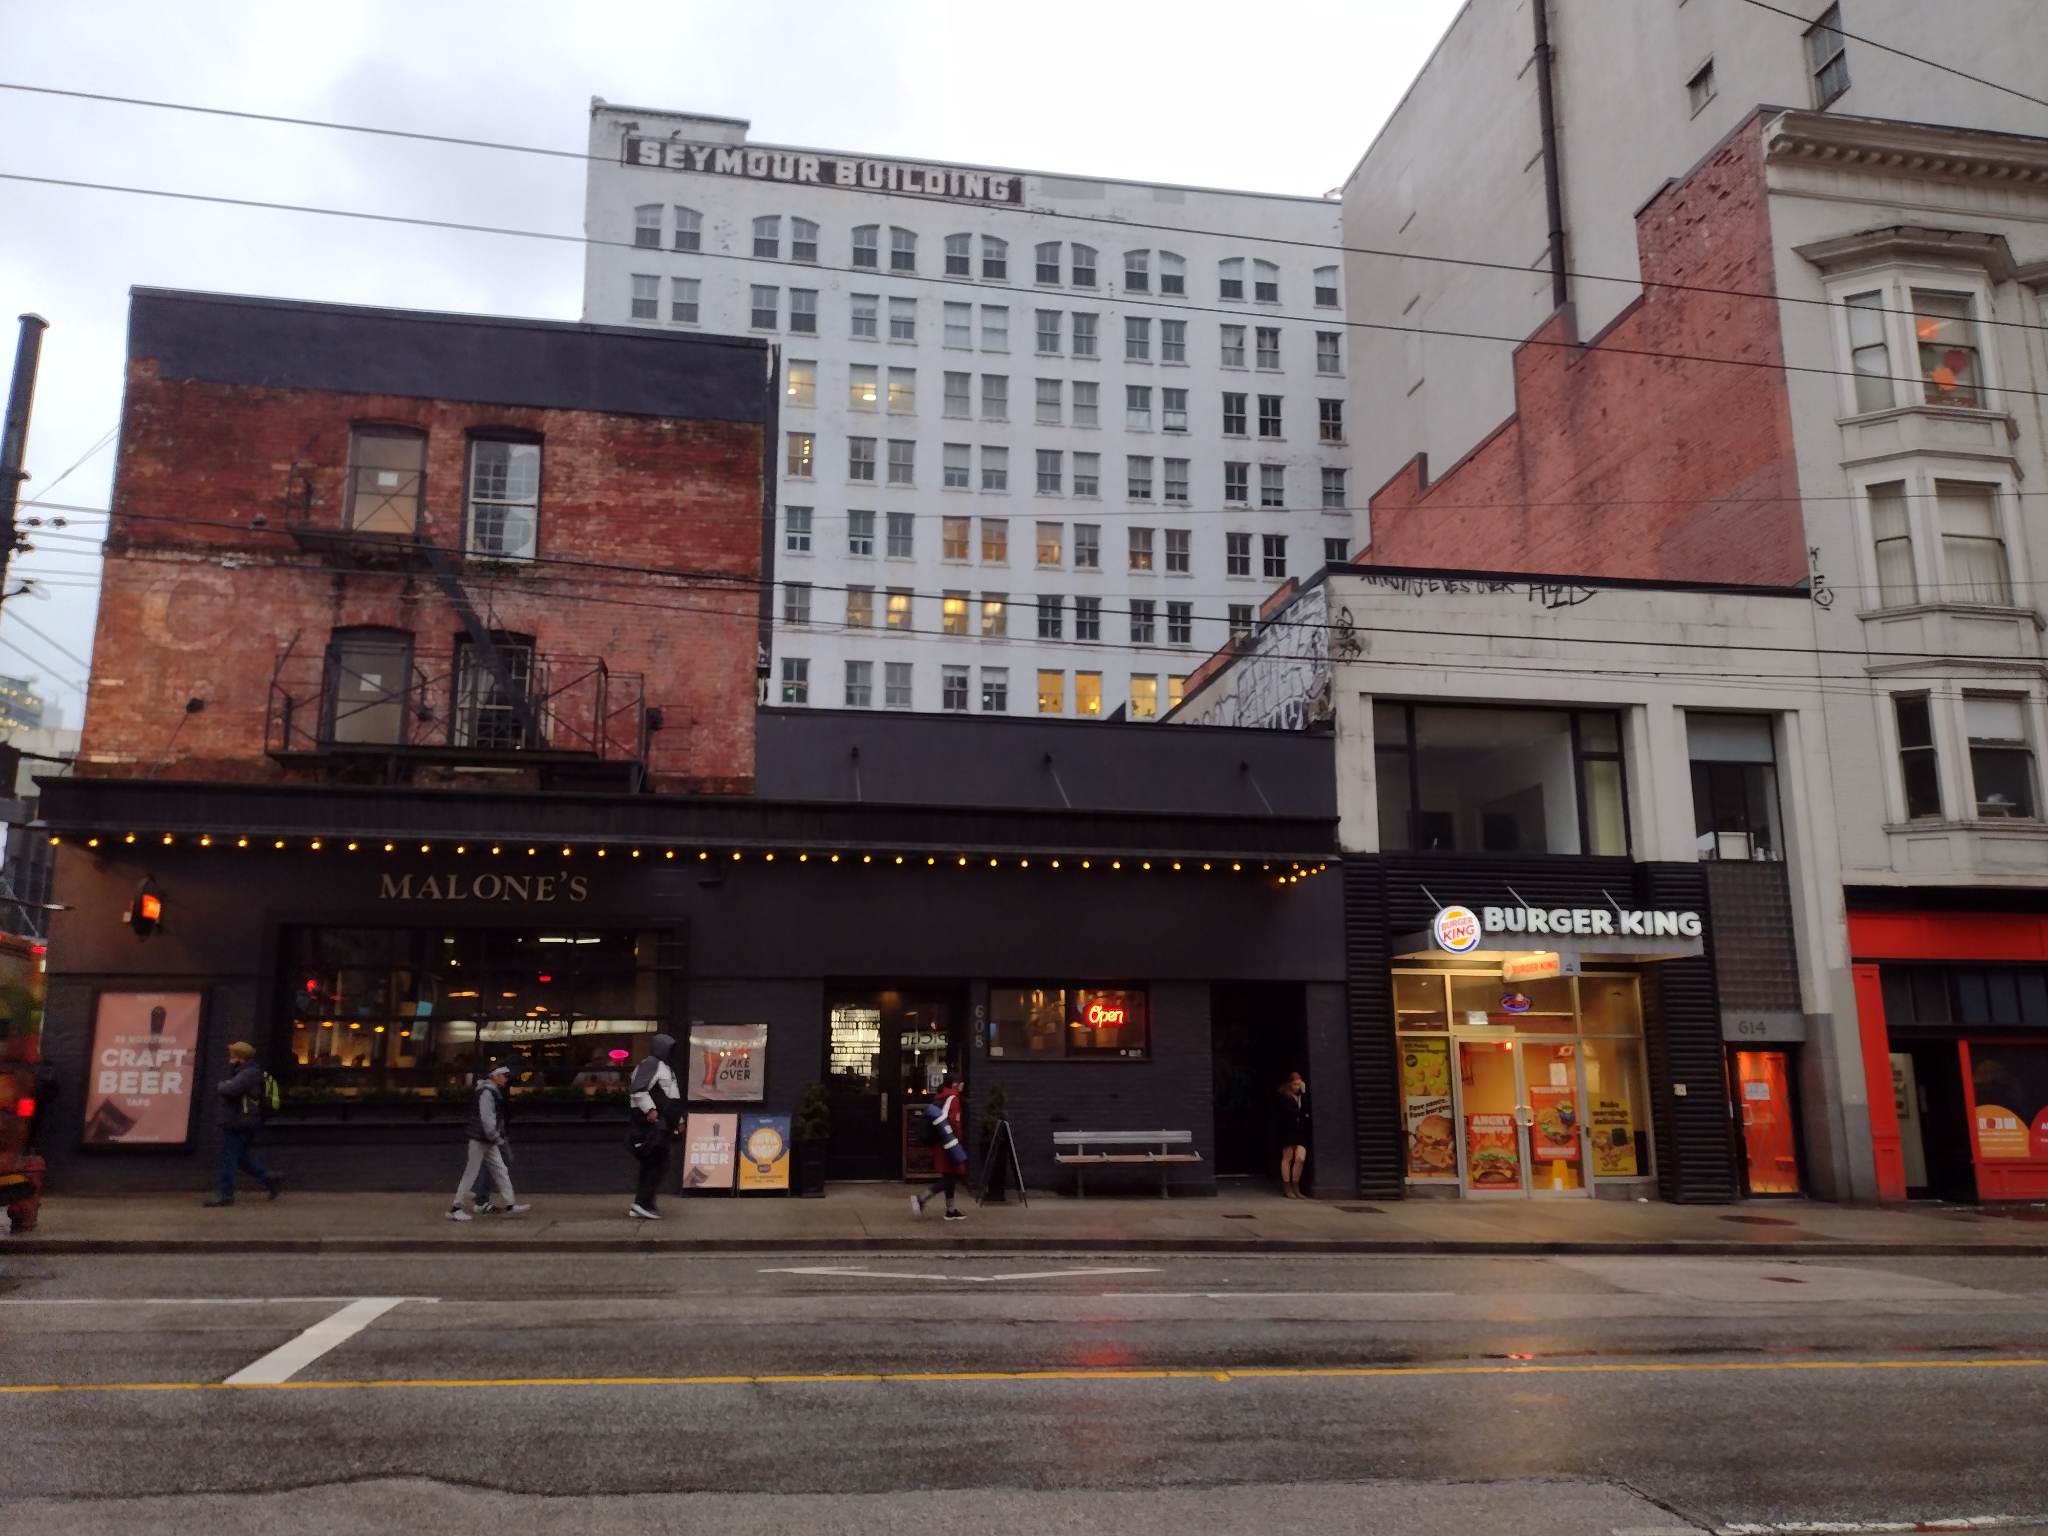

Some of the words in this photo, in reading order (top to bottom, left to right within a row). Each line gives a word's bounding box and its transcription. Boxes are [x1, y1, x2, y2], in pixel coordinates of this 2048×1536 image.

[638, 140, 821, 184] SEYMOUR
[834, 160, 1011, 201] BUILDING
[379, 870, 588, 902] MALONE'S
[1441, 917, 1474, 931] BURGER
[1483, 907, 1615, 936] BURGER
[1620, 910, 1702, 937] KING
[1443, 925, 1476, 942] KING
[1088, 1005, 1124, 1028] Open
[1738, 1020, 1767, 1035] 614
[100, 1048, 188, 1068] CRAFT
[98, 1071, 184, 1095] BEER
[720, 1069, 752, 1081] OVER
[690, 1141, 731, 1153] CRAFT
[689, 1152, 729, 1165] BEER
